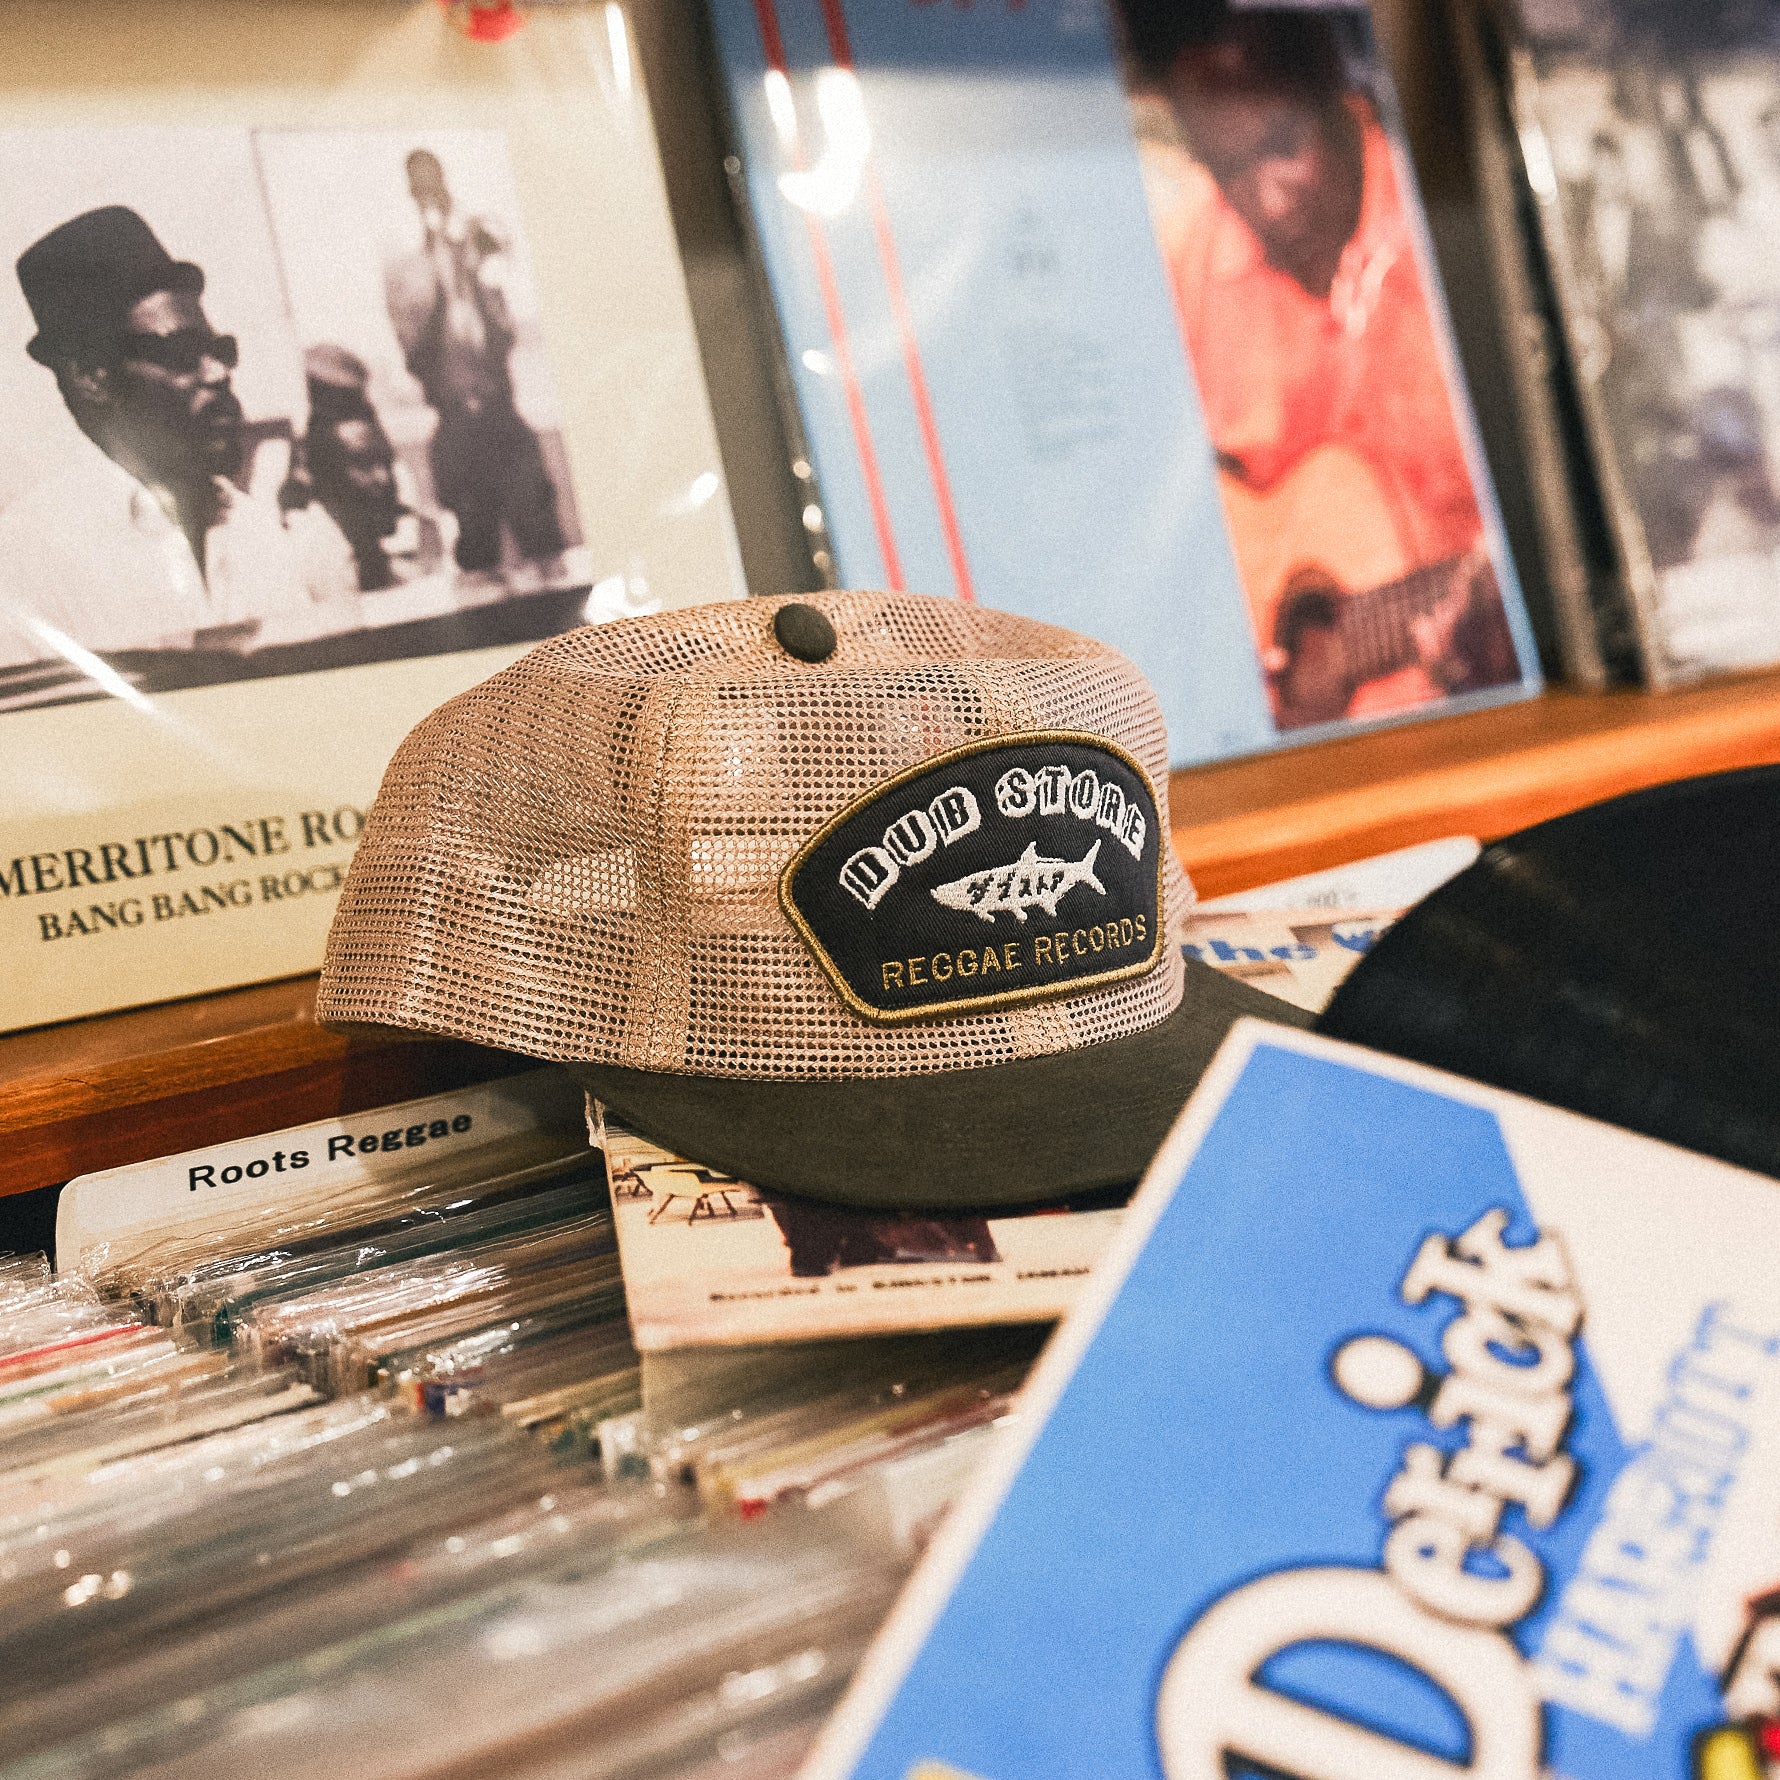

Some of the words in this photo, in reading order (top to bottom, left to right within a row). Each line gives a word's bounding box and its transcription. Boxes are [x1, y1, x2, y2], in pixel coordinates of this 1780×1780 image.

[0, 814, 292, 898] MERRITONE
[839, 786, 981, 910] DUB
[995, 765, 1147, 861] STORE
[38, 896, 145, 943] BANG
[152, 878, 253, 922] BANG
[882, 940, 1022, 991] REGGAE
[1034, 914, 1147, 965] RECORDS
[187, 1147, 311, 1193] Roots
[326, 1112, 473, 1164] Reggae
